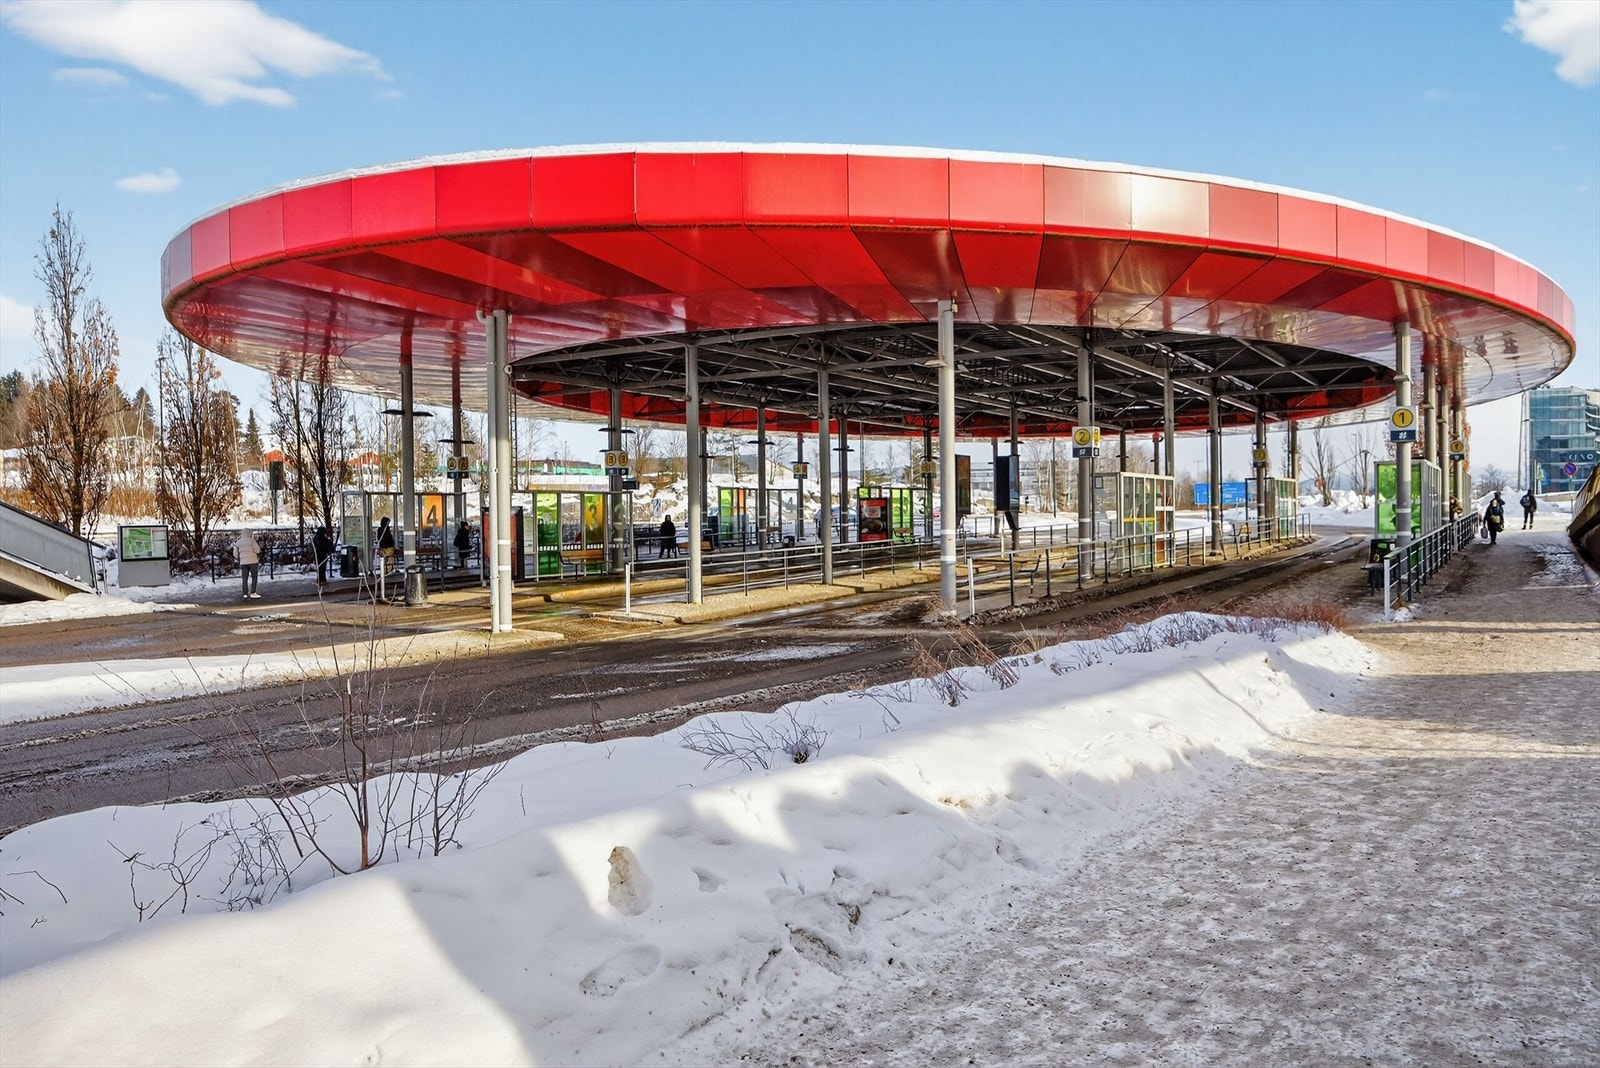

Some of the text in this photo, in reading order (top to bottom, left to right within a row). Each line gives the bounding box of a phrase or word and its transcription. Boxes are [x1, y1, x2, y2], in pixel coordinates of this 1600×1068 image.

[1398, 412, 1405, 424] 1
[1079, 431, 1087, 442] 2
[426, 504, 439, 527] 4
